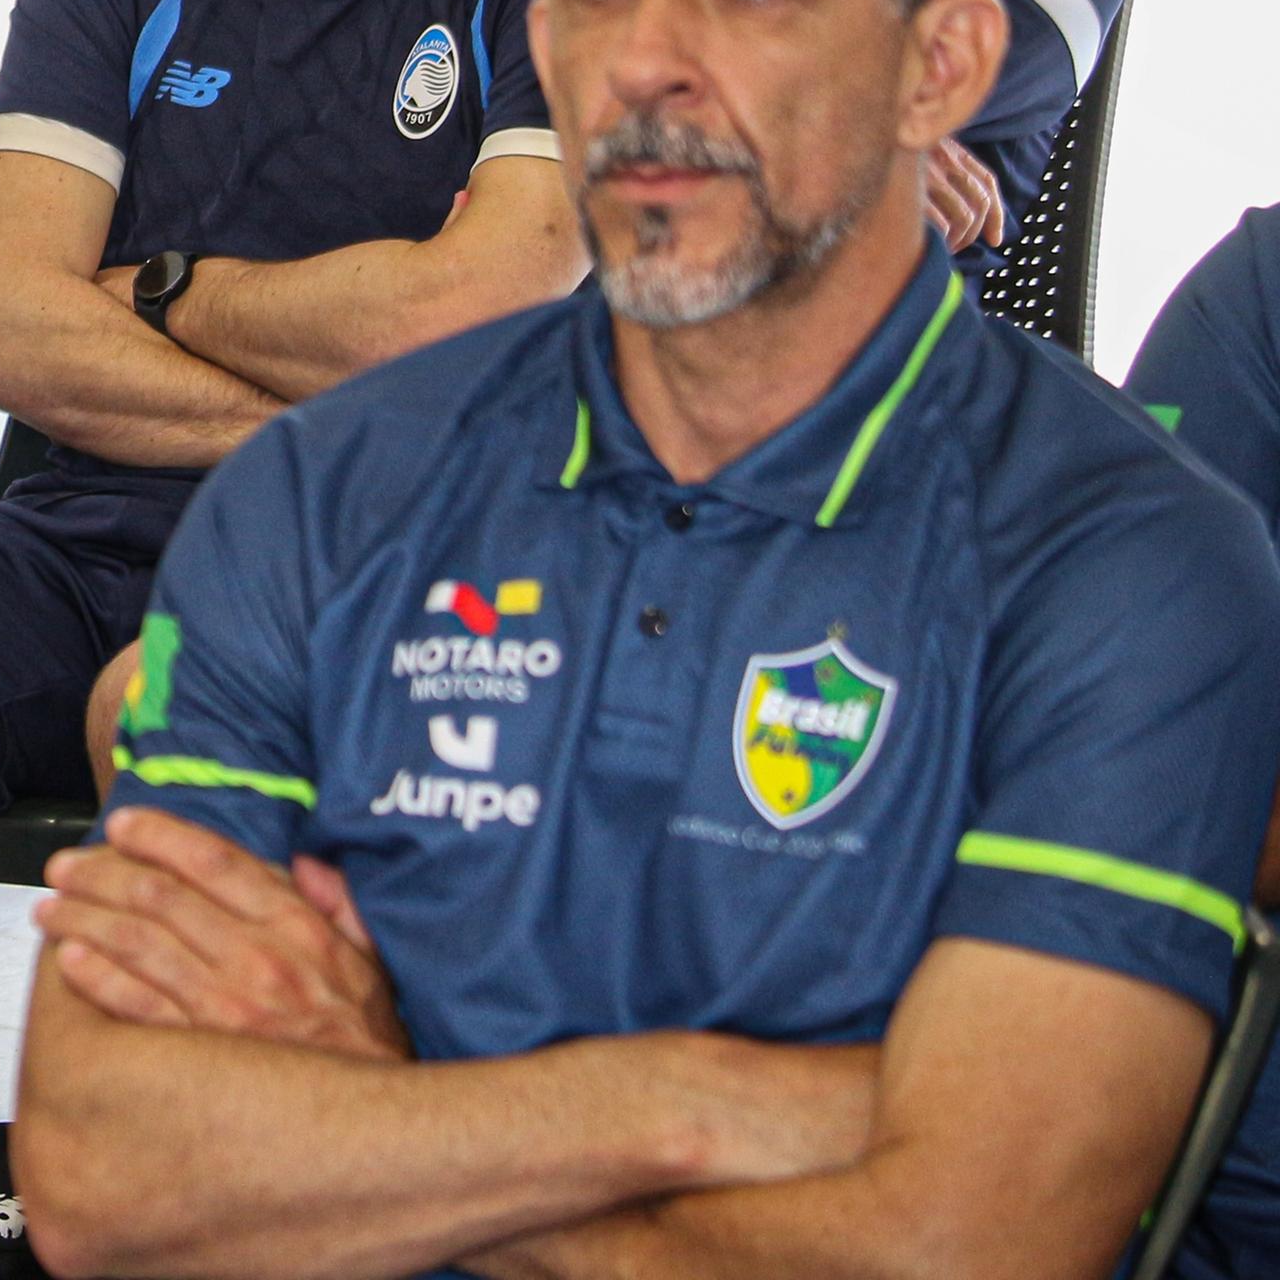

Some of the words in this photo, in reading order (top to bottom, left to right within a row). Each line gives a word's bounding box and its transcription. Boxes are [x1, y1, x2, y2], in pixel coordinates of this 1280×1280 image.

[405, 111, 433, 125] 1907
[392, 636, 562, 678] NOTARO
[410, 672, 530, 704] MOTORS
